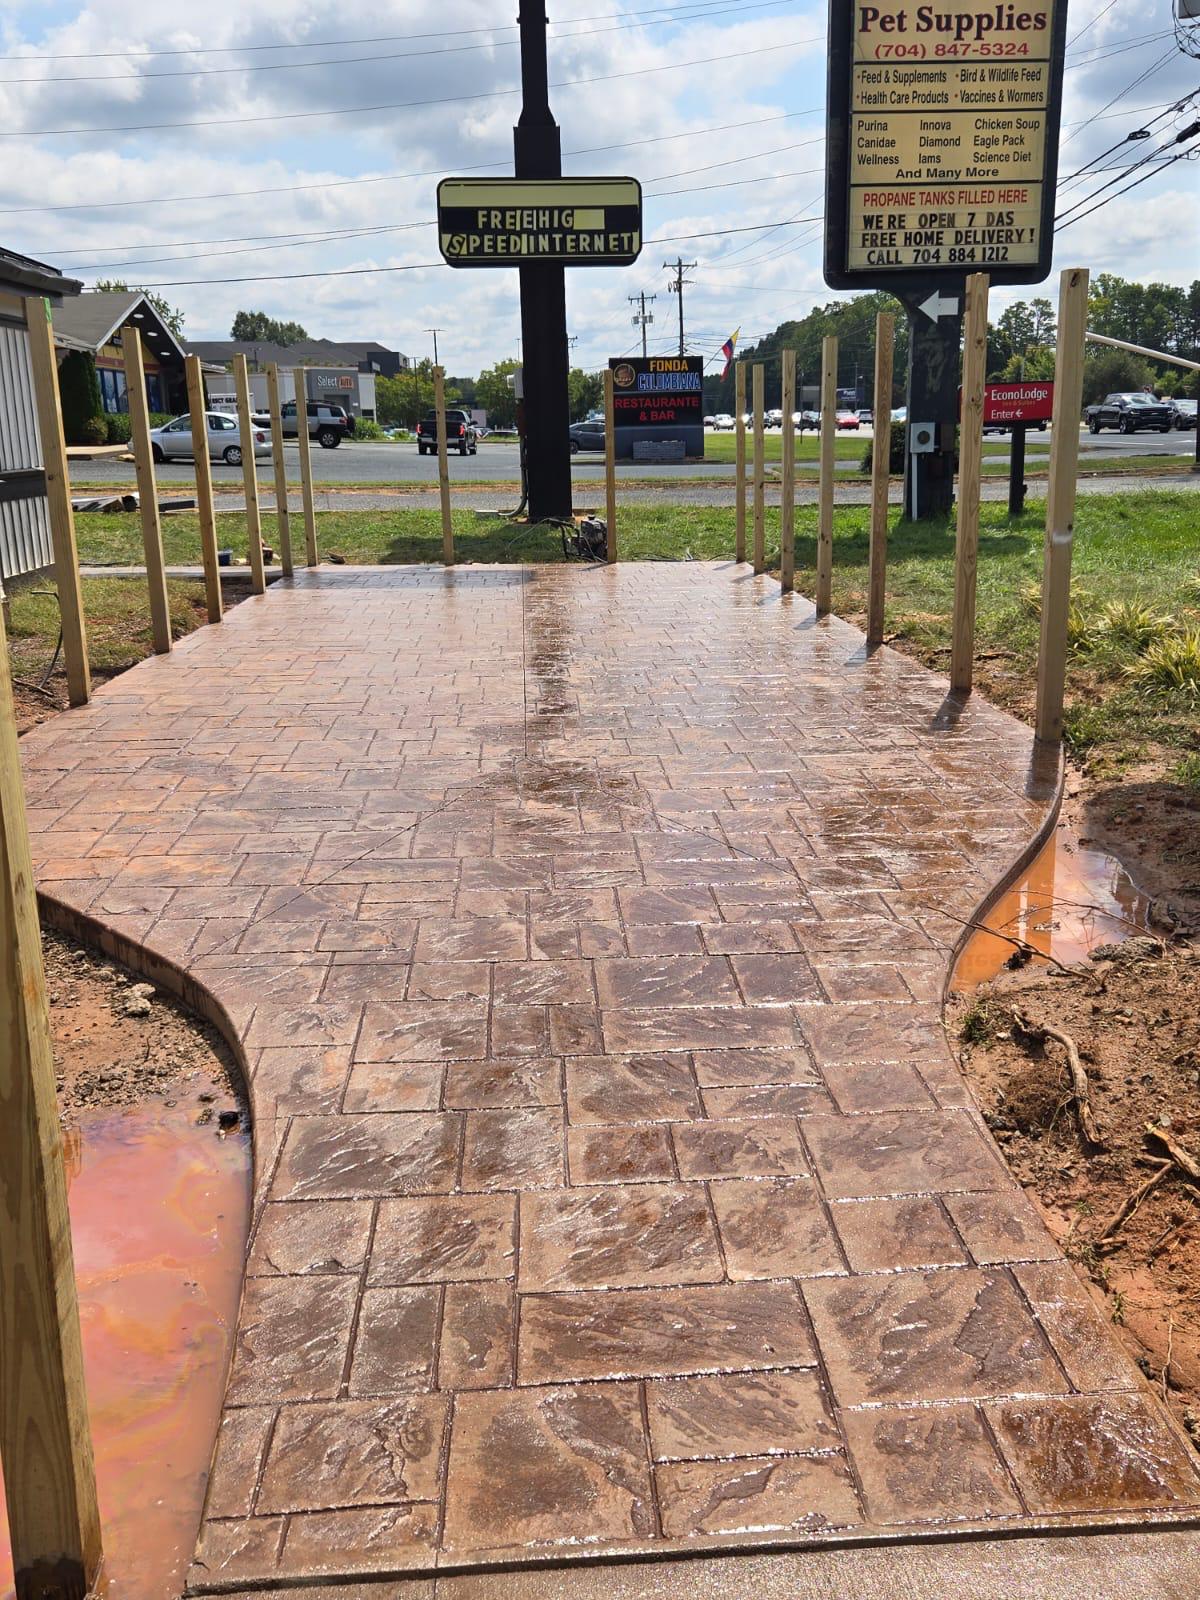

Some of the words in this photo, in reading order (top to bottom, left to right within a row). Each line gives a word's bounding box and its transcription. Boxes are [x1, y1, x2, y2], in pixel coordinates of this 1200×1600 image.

[858, 6, 908, 33] Pet
[916, 4, 1047, 41] Supplies
[875, 44, 927, 59] (704)
[934, 42, 1030, 57] 847-5324
[861, 70, 882, 84] Feed
[884, 71, 891, 83] &
[892, 69, 947, 87] Supplements
[960, 68, 977, 82] Bird
[980, 69, 986, 82] &
[988, 68, 1019, 82] Wildlife
[1021, 68, 1041, 81] Feed
[861, 91, 887, 105] Health
[889, 91, 910, 104] Care
[912, 90, 949, 104] Products
[960, 90, 996, 103] Vaccines
[998, 90, 1005, 102] &
[1007, 89, 1044, 102] Wormers
[858, 119, 888, 131] Purina
[920, 119, 951, 131] Innova
[974, 118, 1012, 130] Chicken
[1015, 118, 1040, 131] Soup
[857, 136, 896, 148] Canidae
[919, 135, 961, 147] Diamond
[973, 135, 1000, 148] Eagle
[1002, 134, 1025, 146] Pack
[857, 153, 899, 165] Wellness
[918, 153, 941, 164] Iams
[973, 151, 1010, 163] Science
[1012, 151, 1032, 162] Diet
[895, 168, 922, 179] And
[926, 168, 962, 180] Many
[965, 167, 999, 178] More
[863, 192, 916, 207] PROPANE
[918, 191, 955, 206] TANKS
[958, 190, 995, 205] FILLED
[998, 189, 1028, 203] HERE
[918, 213, 956, 228] OPEN
[967, 212, 976, 227] 7
[986, 211, 1015, 227] DAS
[861, 232, 897, 247] FREE
[903, 231, 944, 246] HOME
[867, 249, 902, 265] CALL
[912, 248, 941, 264] 704
[948, 247, 976, 262] 884
[982, 246, 1008, 262] 1212
[650, 360, 688, 371] FONDA
[317, 375, 337, 386] Select
[638, 373, 701, 390] COLOMBIANA
[991, 387, 1048, 401] EconoLodge
[615, 398, 699, 408] RESTAURANTE
[639, 411, 648, 421] &
[650, 410, 675, 420] BAR
[991, 409, 1014, 419] Enter
